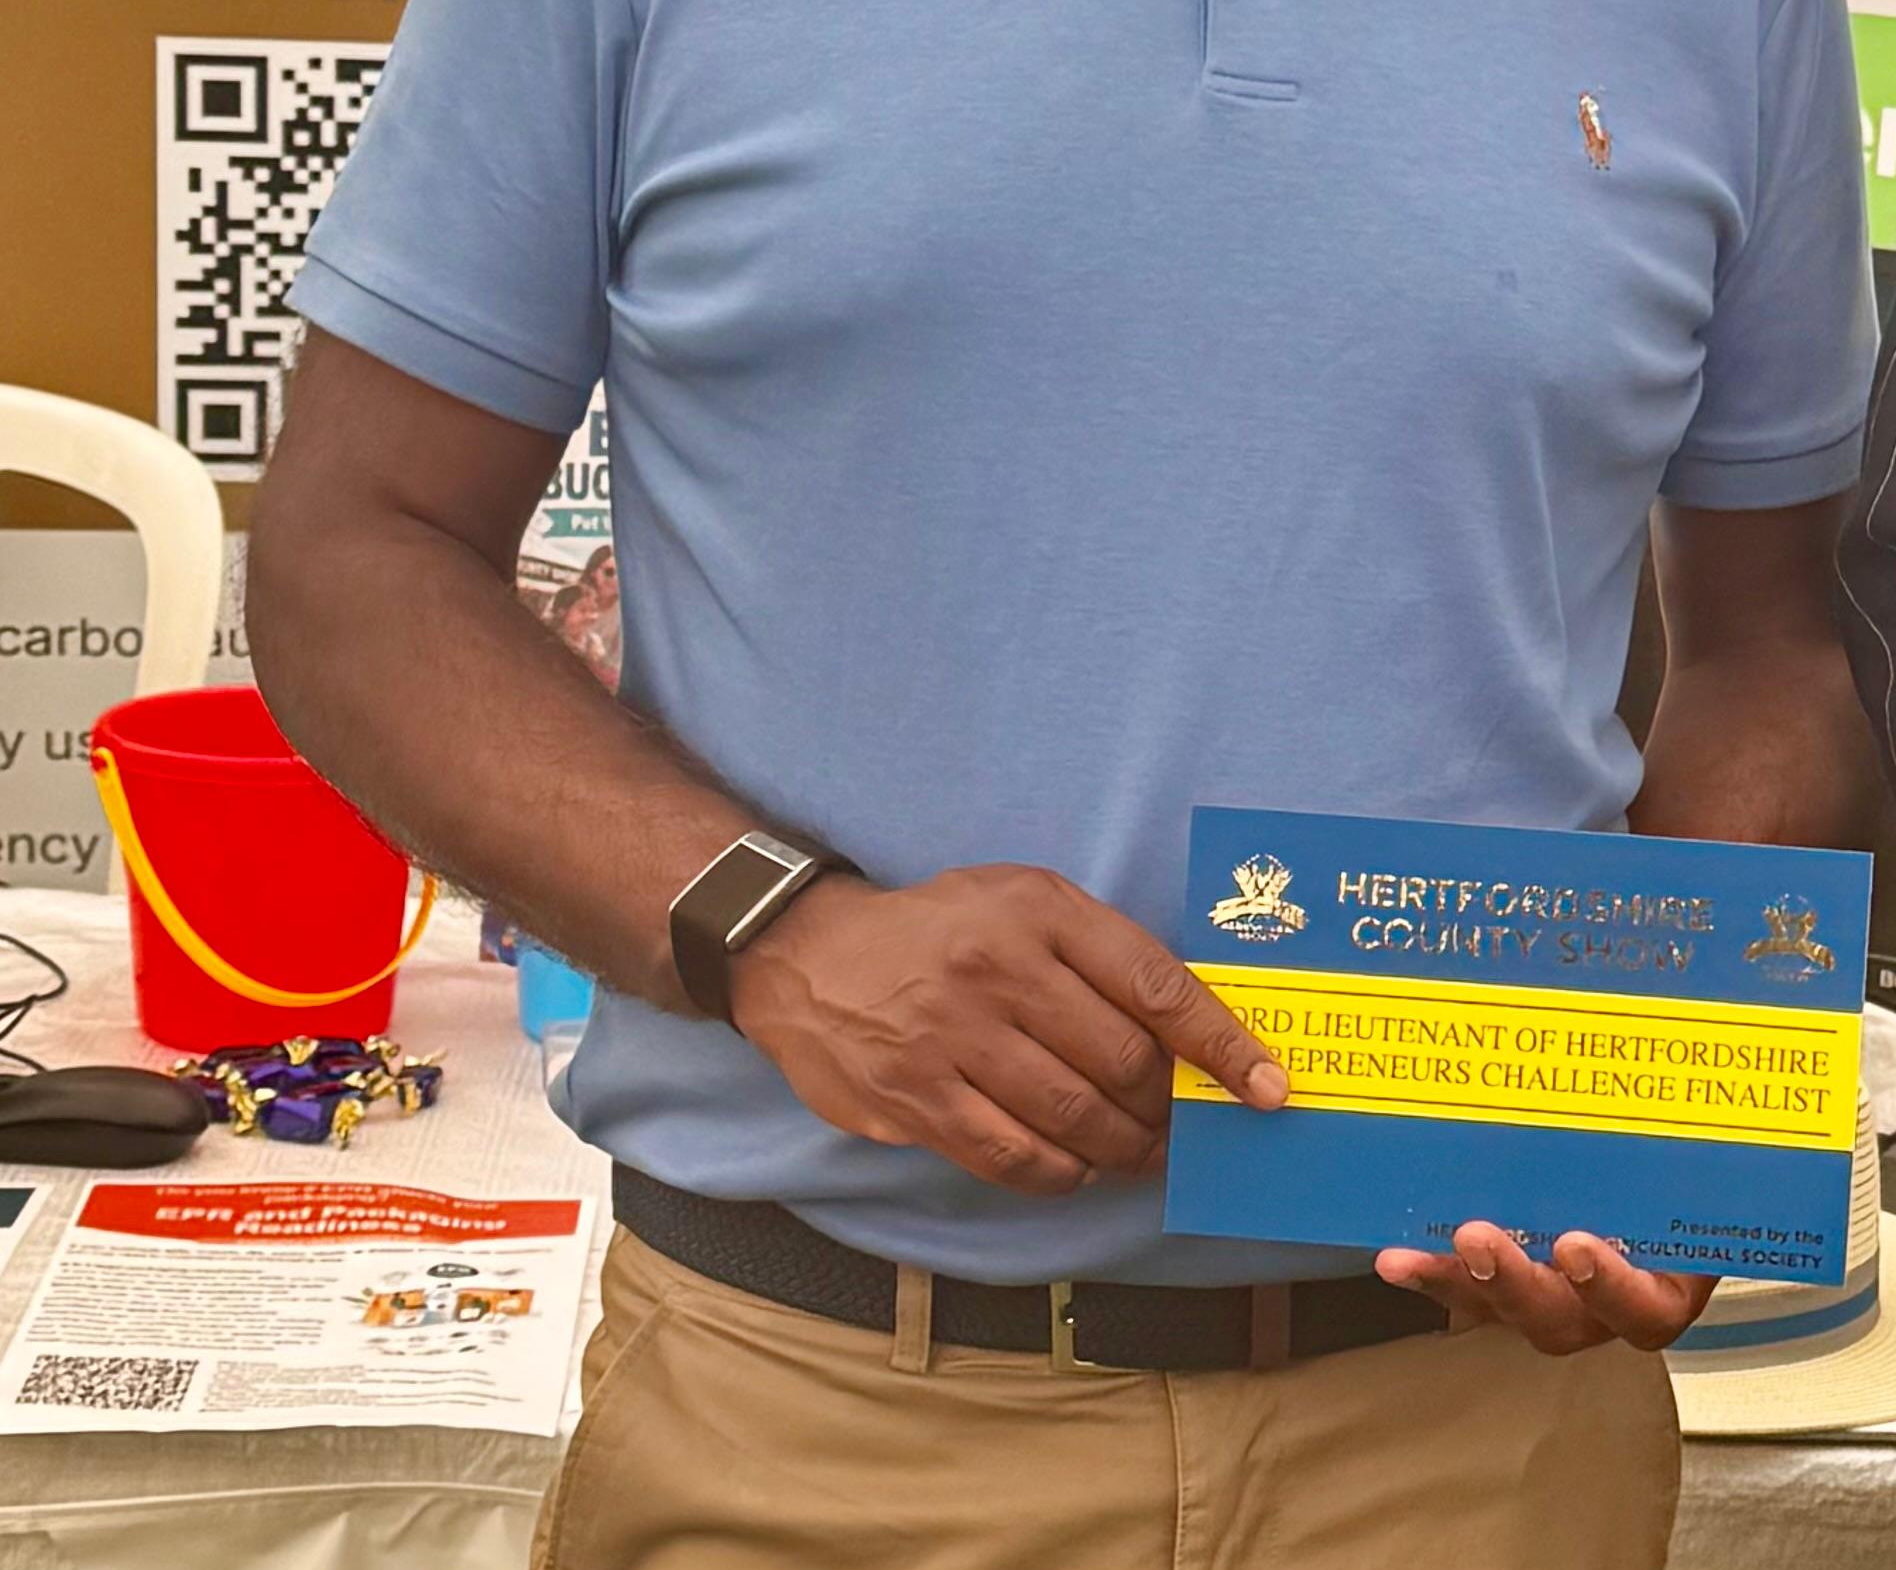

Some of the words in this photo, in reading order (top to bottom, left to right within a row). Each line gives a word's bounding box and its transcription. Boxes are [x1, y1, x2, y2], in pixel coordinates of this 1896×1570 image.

[0, 618, 143, 657] carbo
[0, 832, 99, 874] ncy
[1337, 871, 1714, 931] HERTFORDSHIRE
[1351, 916, 1541, 959] COUNTY
[1557, 936, 1695, 973] SHOW
[1229, 1006, 1293, 1033] RD
[1304, 1012, 1509, 1053] LIEUTENANT
[1515, 1028, 1557, 1055] OF
[1565, 1030, 1831, 1077] HERTFORDSHIRE
[1480, 1061, 1677, 1103] CHALLENGE
[1686, 1078, 1831, 1115] FINALIST
[1671, 1219, 1762, 1240] Presented
[1767, 1228, 1791, 1245] by
[1795, 1231, 1823, 1245] the
[1741, 1248, 1823, 1270] SOCIETY
